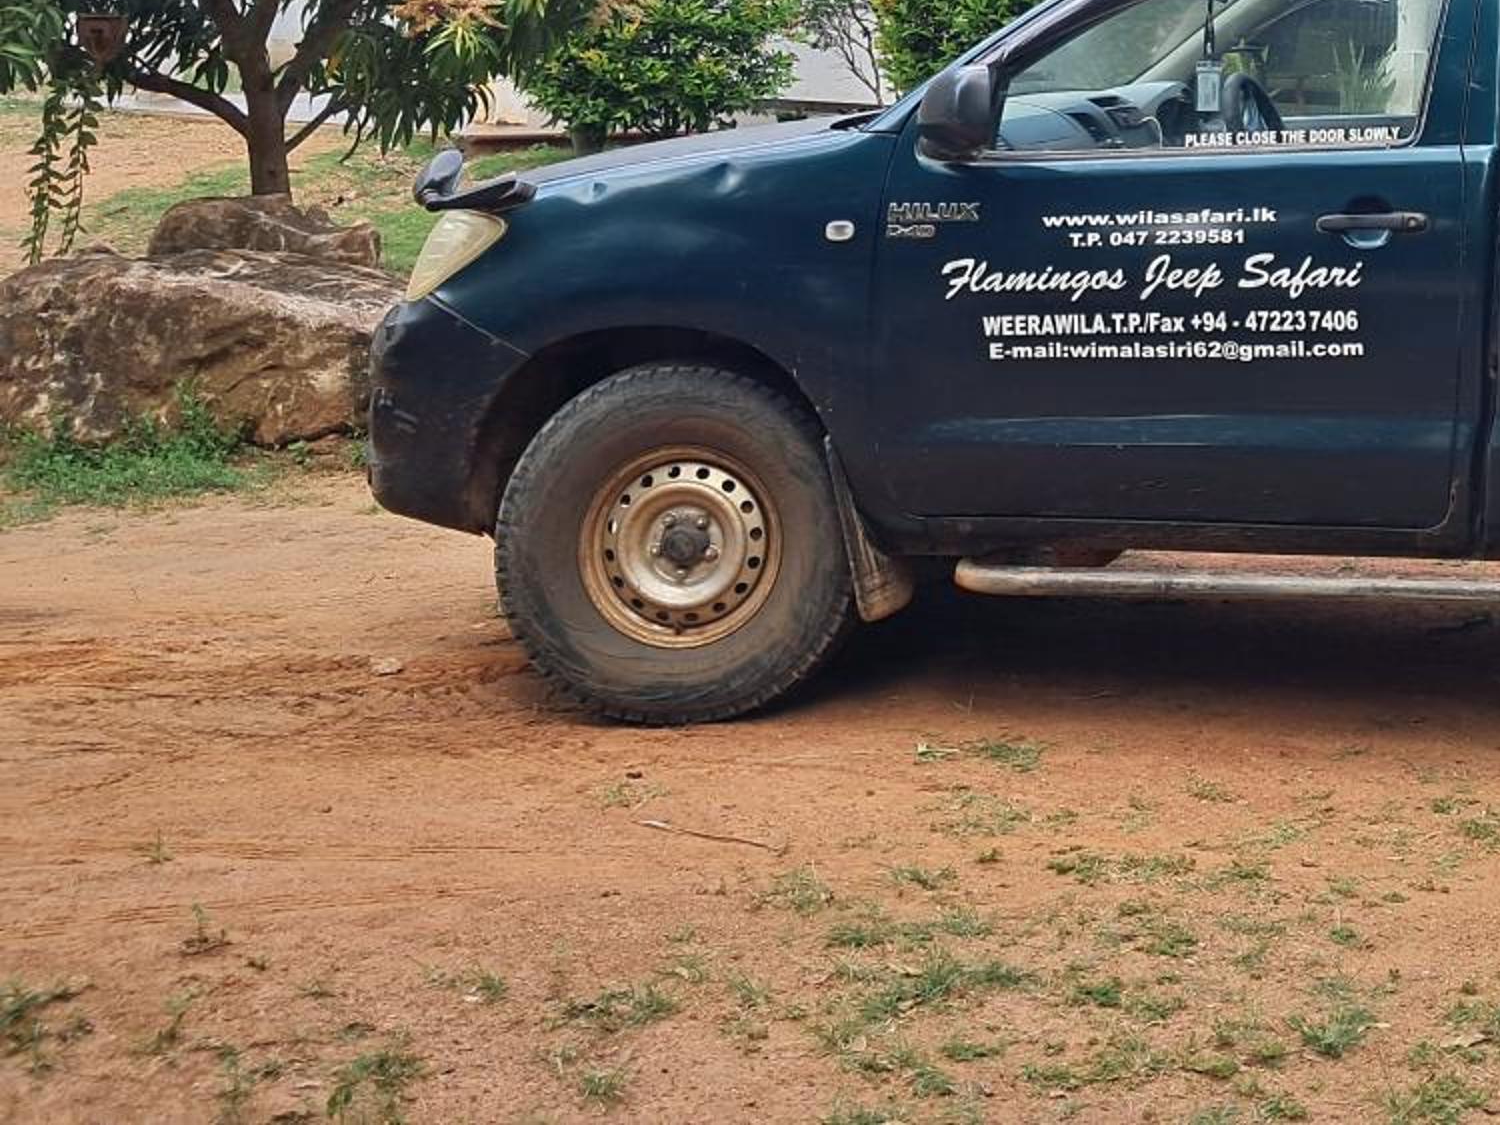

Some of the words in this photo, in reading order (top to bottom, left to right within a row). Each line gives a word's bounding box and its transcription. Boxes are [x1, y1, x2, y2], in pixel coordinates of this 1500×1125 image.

[1184, 131, 1233, 148] PLEASE
[1235, 130, 1277, 146] CLOSE
[1280, 129, 1306, 145] THE
[1308, 128, 1346, 143] DOOR
[1348, 126, 1401, 142] SLOWLY
[887, 202, 981, 222] HILUX
[1041, 207, 1278, 228] www.wilasafari.lk
[1068, 232, 1103, 248] T.P.
[1108, 230, 1149, 247] 047
[1153, 228, 1245, 245] 2239581
[941, 257, 1127, 302] Flamingos
[1139, 253, 1224, 301] Jeep
[1237, 252, 1363, 300] Safari
[1190, 311, 1228, 334] +94
[988, 340, 1365, 362] E-mail:wimalasiri62@gmail.com
